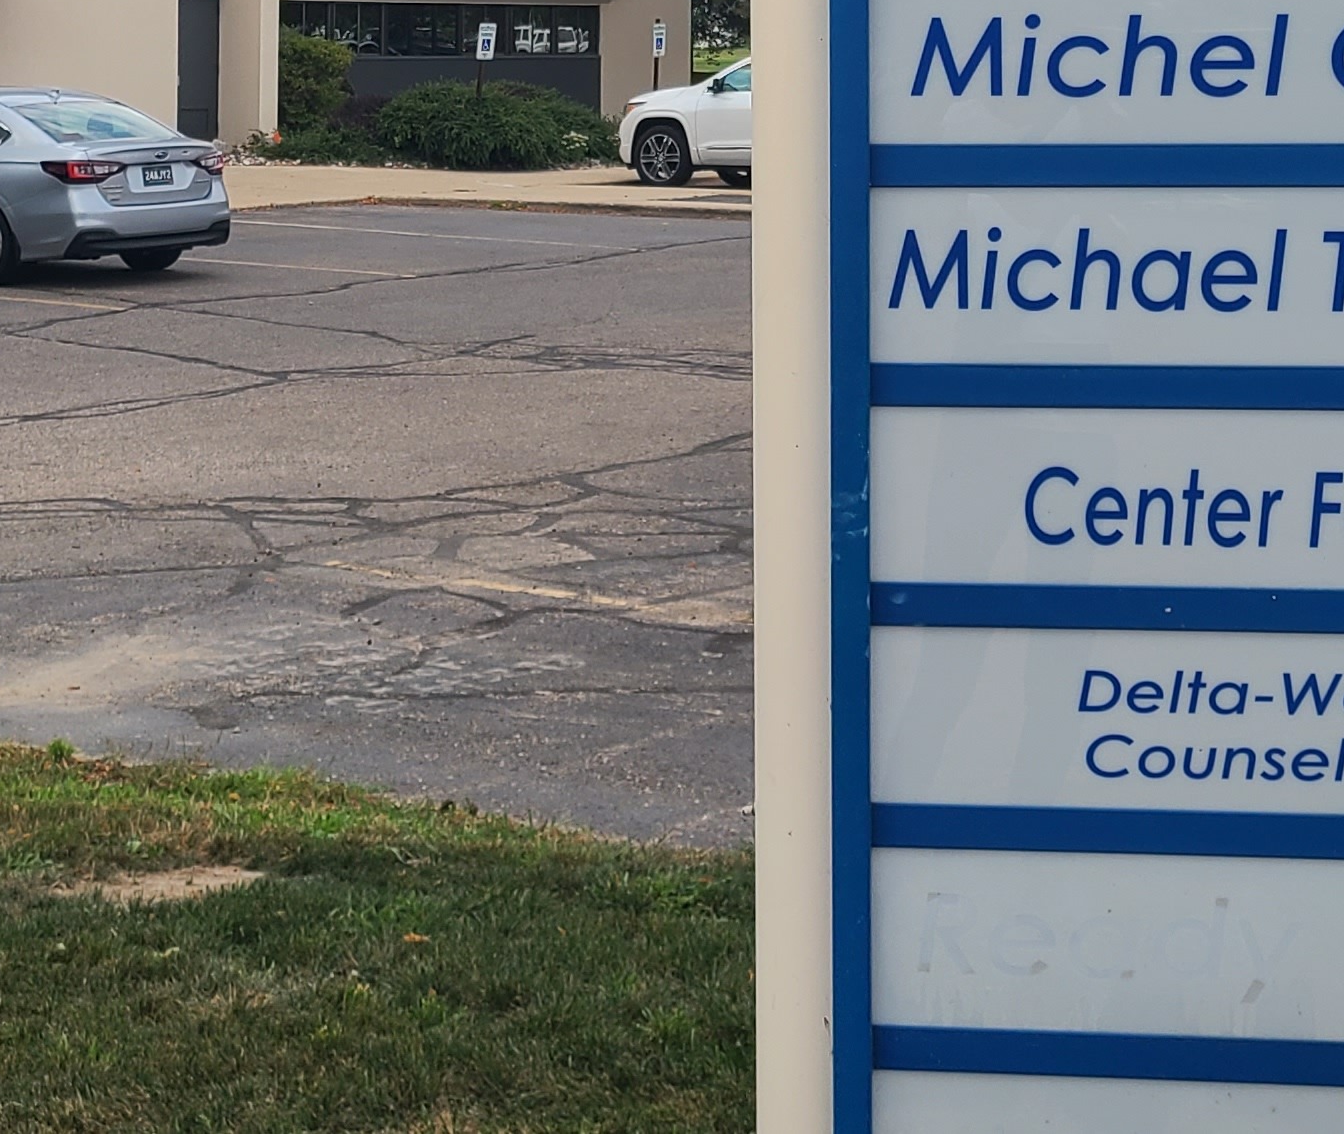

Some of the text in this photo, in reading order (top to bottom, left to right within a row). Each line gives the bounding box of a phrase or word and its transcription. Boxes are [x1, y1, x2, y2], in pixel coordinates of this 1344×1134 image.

[910, 13, 1290, 99] Michel
[887, 226, 1289, 313] Michael
[1024, 465, 1285, 549] Center
